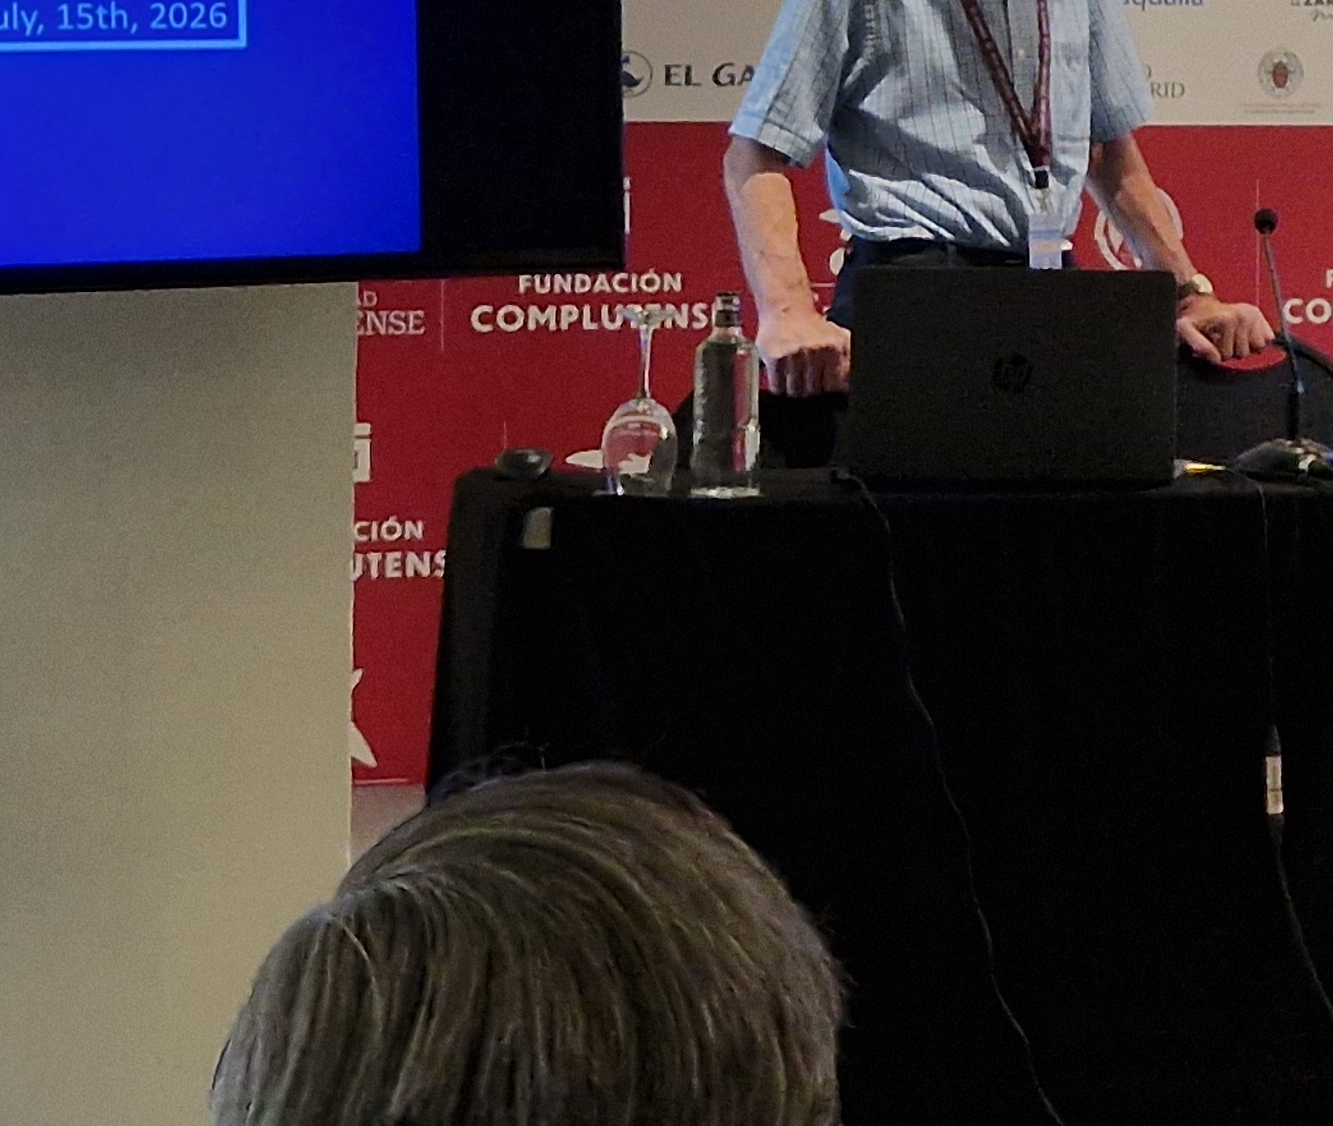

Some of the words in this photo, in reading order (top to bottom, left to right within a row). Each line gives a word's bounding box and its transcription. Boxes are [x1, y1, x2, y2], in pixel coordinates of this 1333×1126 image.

[57, 0, 138, 34] 15th,
[150, 2, 227, 30] 2026
[664, 63, 702, 87] EL
[712, 62, 757, 88] GA
[1150, 81, 1186, 99] RID
[518, 268, 682, 294] FUNDACIÓN
[471, 302, 713, 333] COMPLUTENS
[354, 515, 424, 542] CIÓN
